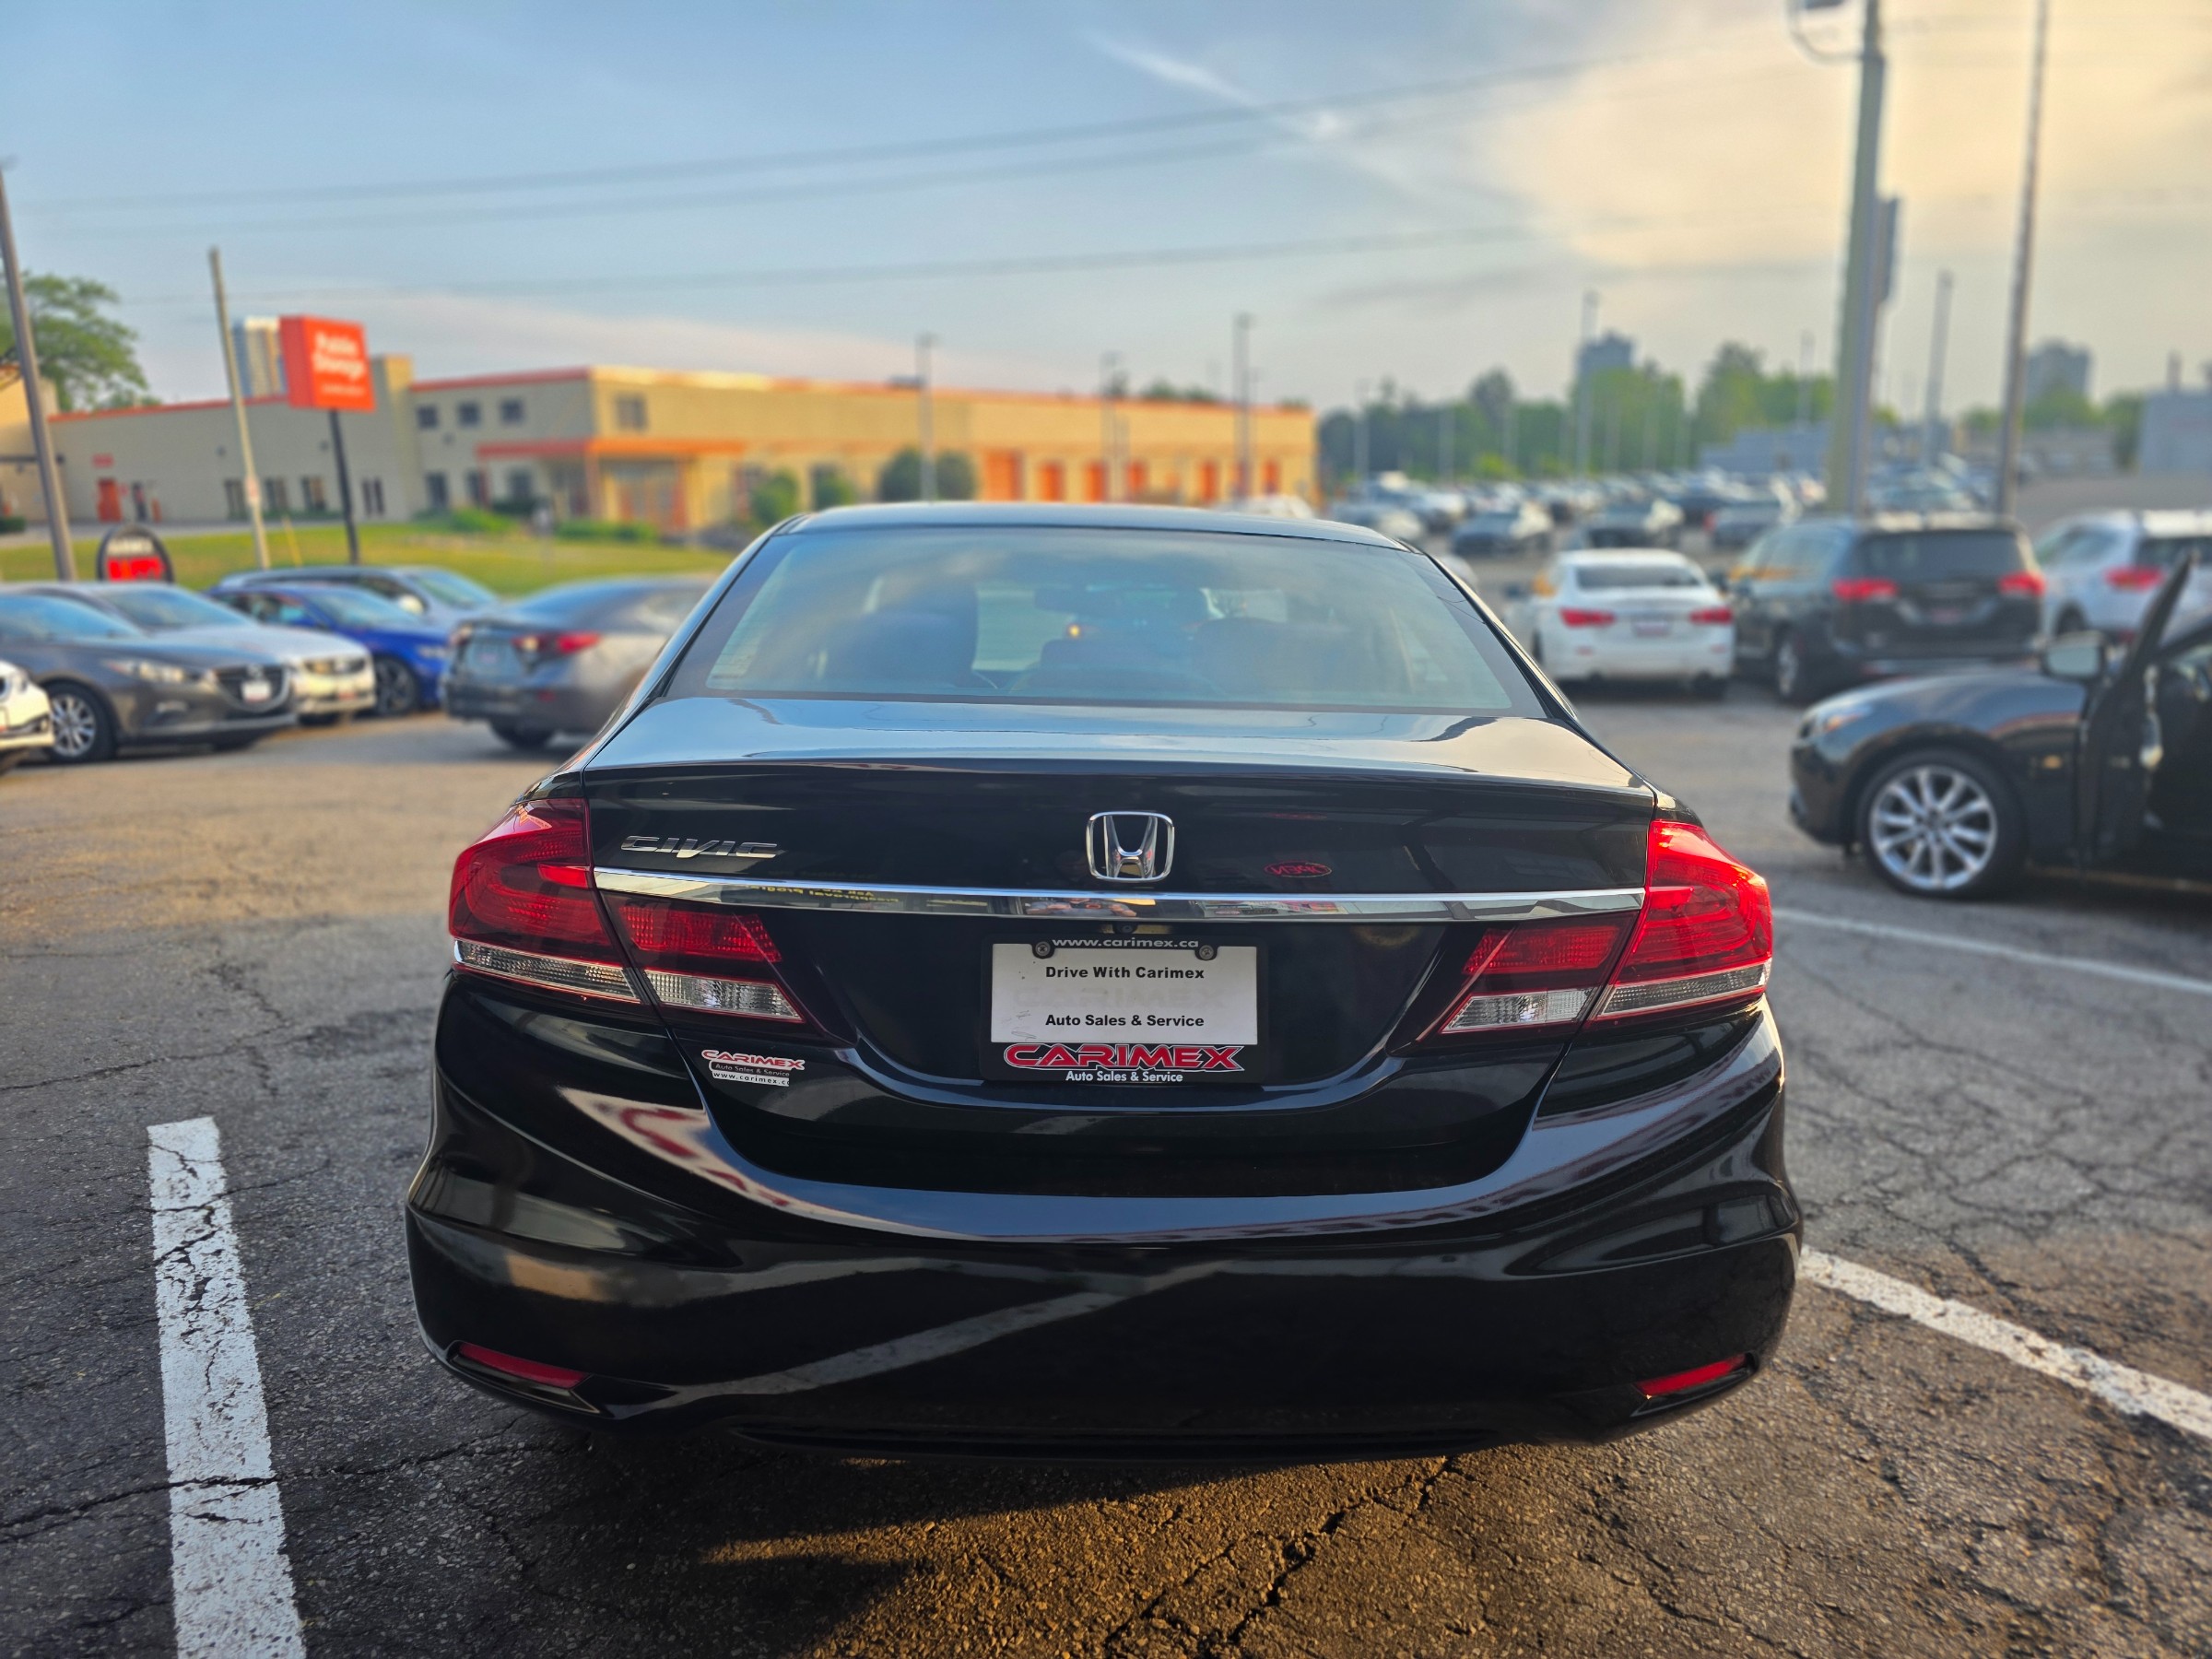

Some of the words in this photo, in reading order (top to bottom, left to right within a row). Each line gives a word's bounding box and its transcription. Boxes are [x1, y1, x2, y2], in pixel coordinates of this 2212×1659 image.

[620, 835, 778, 859] CIVIC
[1052, 937, 1199, 948] www.carimex.ca
[1045, 966, 1088, 979] Drive
[1093, 966, 1131, 979] With
[1135, 967, 1205, 979] Carimex
[1045, 1015, 1081, 1027] Auto
[1085, 1015, 1126, 1027] Sales
[1131, 1015, 1142, 1027] &
[1147, 1015, 1205, 1027] Service
[702, 1051, 805, 1069] CARIMEX
[1005, 1044, 1244, 1071] CARIMEX
[715, 1063, 733, 1071] Auto
[735, 1065, 754, 1074] Sales
[764, 1068, 790, 1077] Service
[1065, 1070, 1093, 1081] Auto
[1097, 1071, 1127, 1081] Sales
[1130, 1071, 1139, 1081] &
[1142, 1071, 1183, 1082] Service
